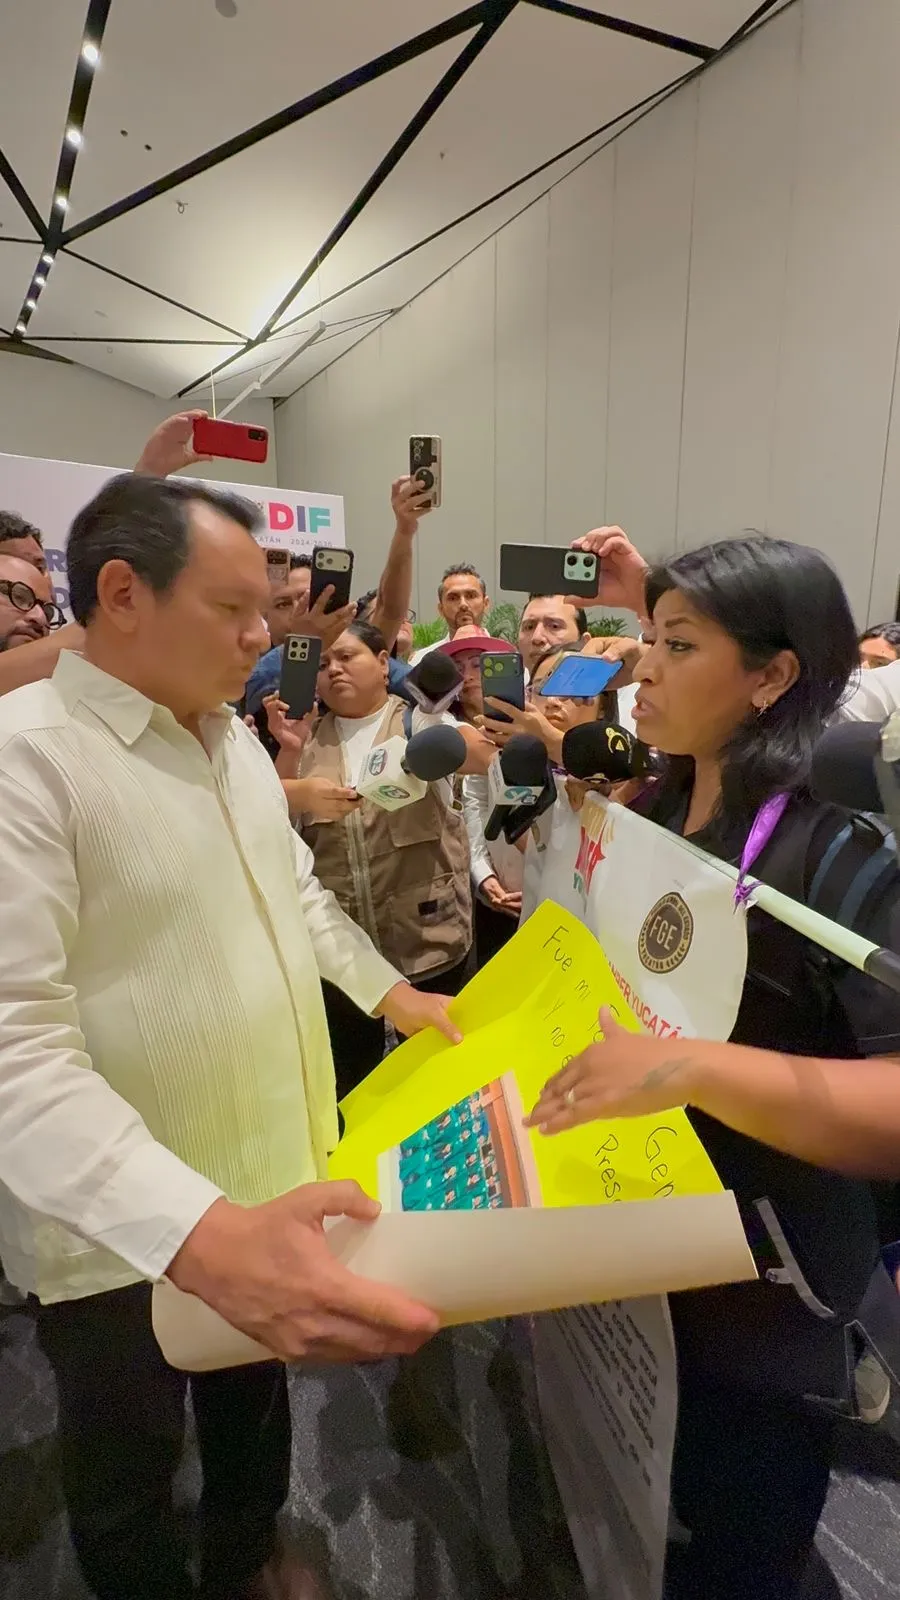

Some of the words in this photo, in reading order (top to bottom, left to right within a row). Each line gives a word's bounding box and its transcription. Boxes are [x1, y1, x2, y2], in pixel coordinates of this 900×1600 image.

[268, 502, 330, 533] DIF
[543, 925, 572, 972] Fue
[649, 915, 678, 950] FGE
[632, 991, 683, 1039] YUCATÁ
[551, 1026, 566, 1047] no
[595, 1133, 622, 1203] Pres
